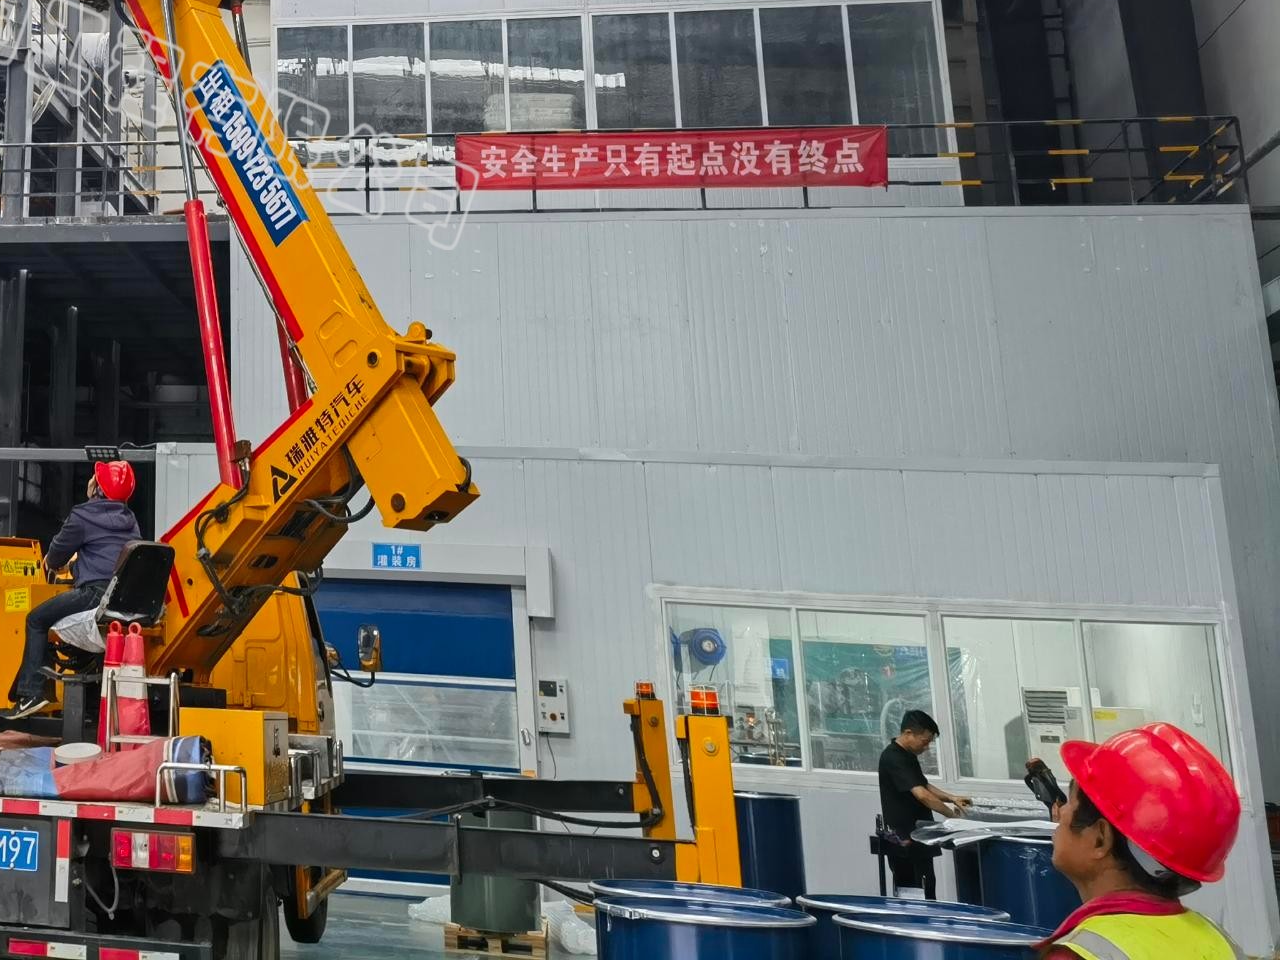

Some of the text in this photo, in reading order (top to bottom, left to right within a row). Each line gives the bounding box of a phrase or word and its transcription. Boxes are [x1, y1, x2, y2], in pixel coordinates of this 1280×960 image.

[199, 68, 297, 230] 出租 1599 723 5677
[480, 137, 864, 178] 安全生产只有起点没有终点
[284, 373, 365, 468] 瑞雅特汽车
[390, 545, 404, 555] 1#
